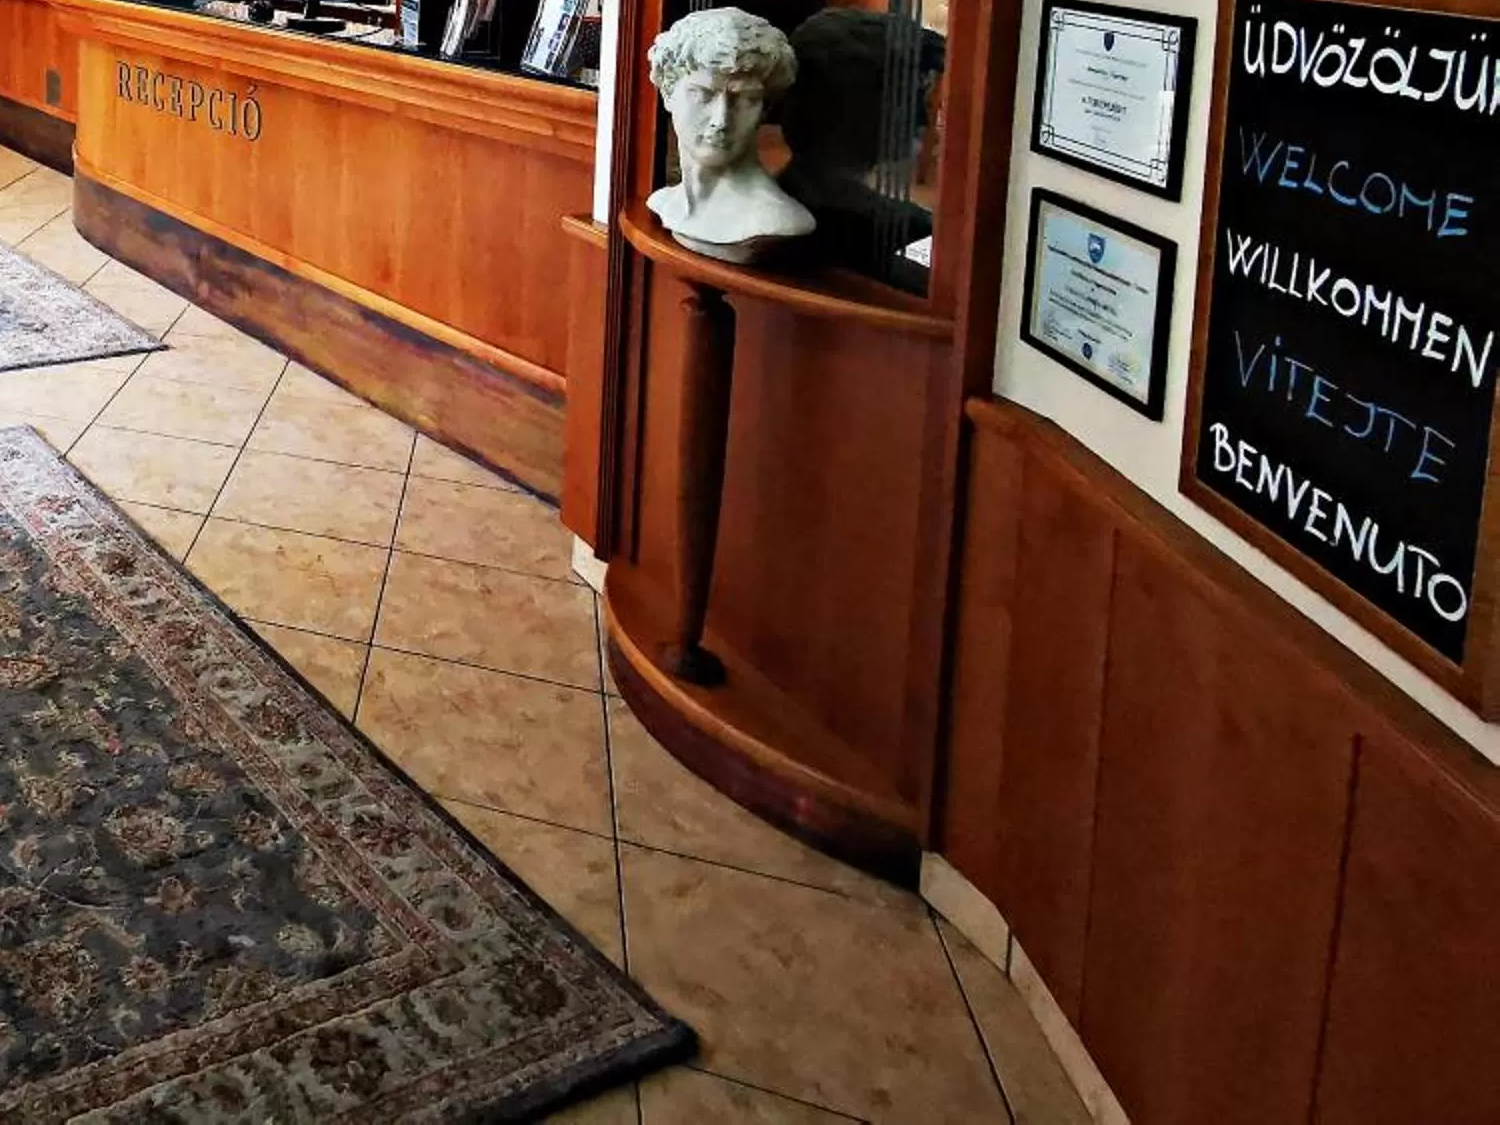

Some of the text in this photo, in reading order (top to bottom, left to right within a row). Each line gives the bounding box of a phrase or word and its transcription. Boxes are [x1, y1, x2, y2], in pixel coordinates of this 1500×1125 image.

[116, 61, 262, 141] RECEPCIÓ
[1238, 125, 1475, 236] WELCOME
[1227, 228, 1493, 388] WILLKOMMEN
[1209, 423, 1467, 622] BENVENUTO
